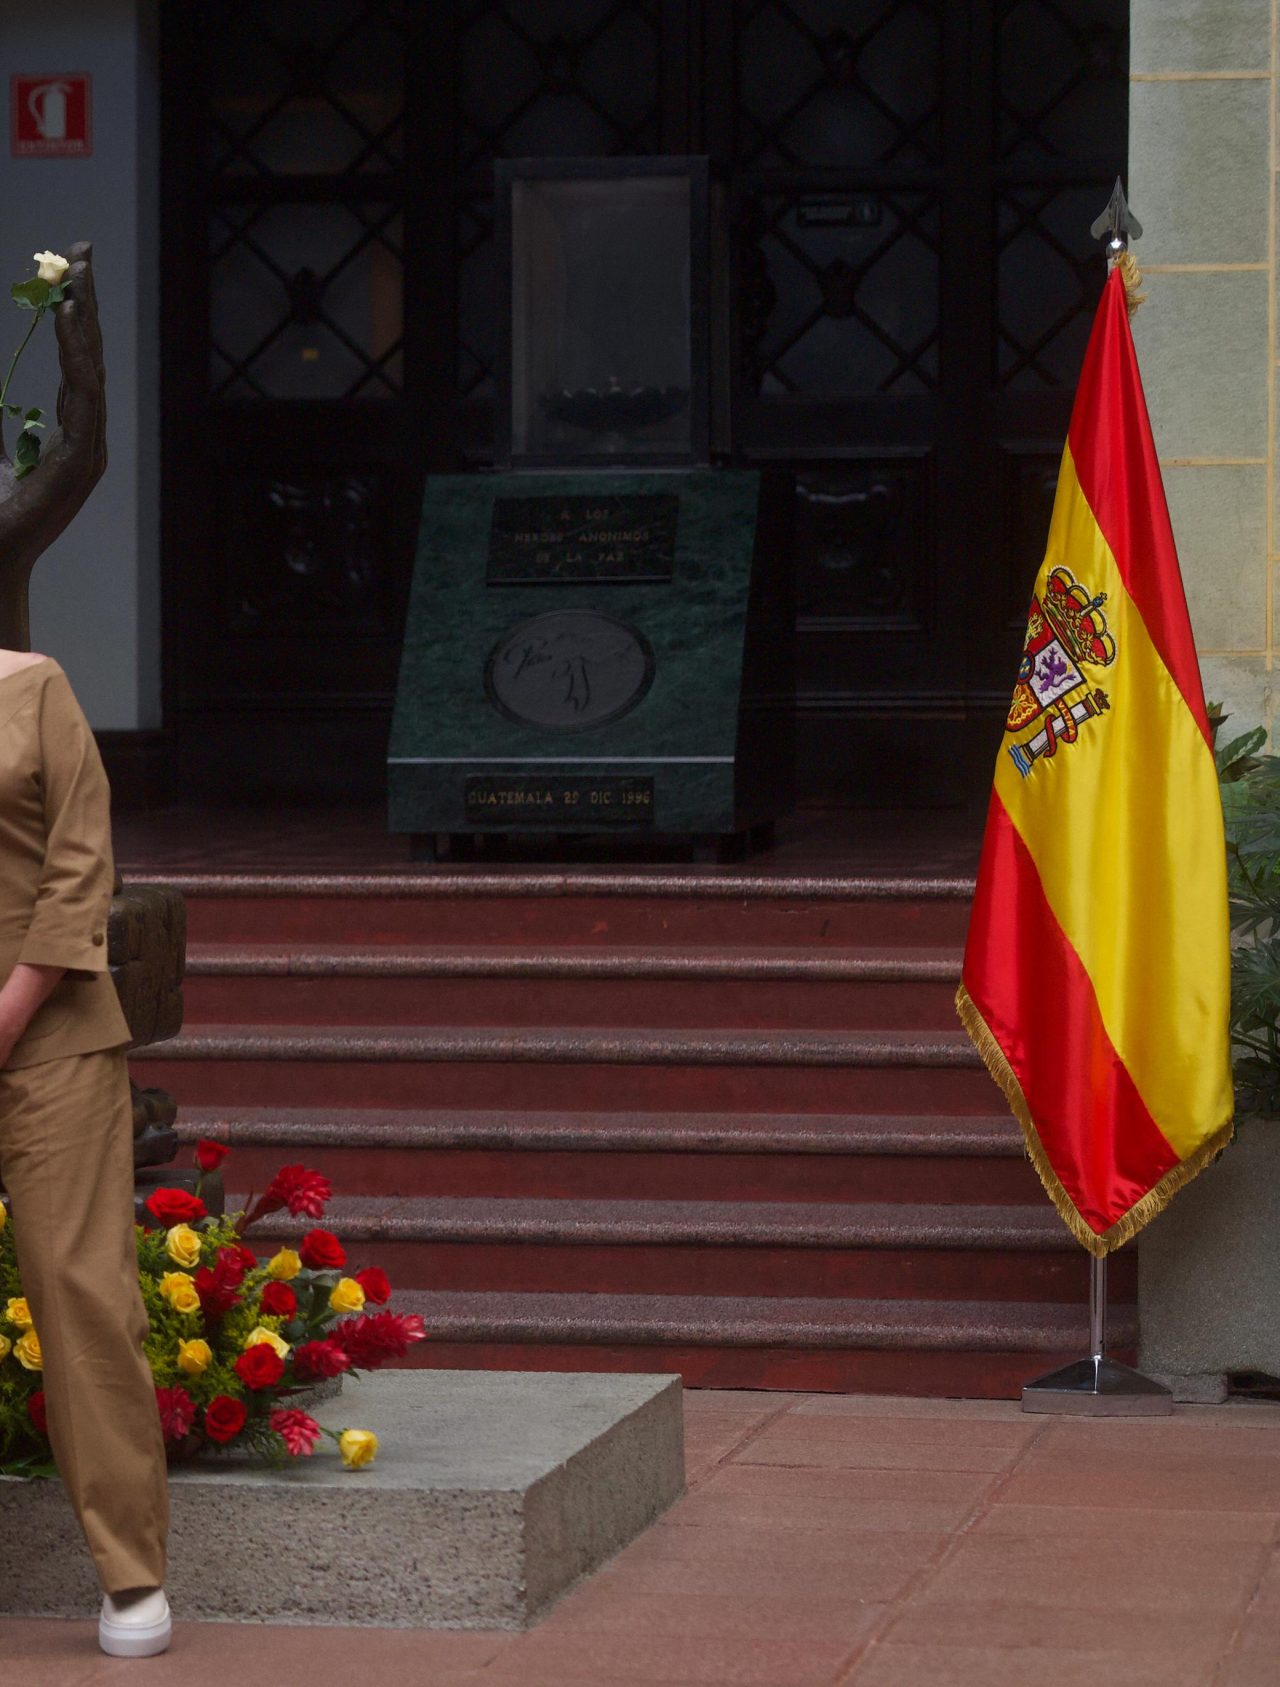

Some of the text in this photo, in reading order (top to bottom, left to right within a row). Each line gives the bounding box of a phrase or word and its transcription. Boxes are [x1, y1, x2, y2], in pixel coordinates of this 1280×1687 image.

[566, 552, 582, 563] LA
[467, 791, 554, 805] GUATEMALA
[590, 791, 612, 805] DIC
